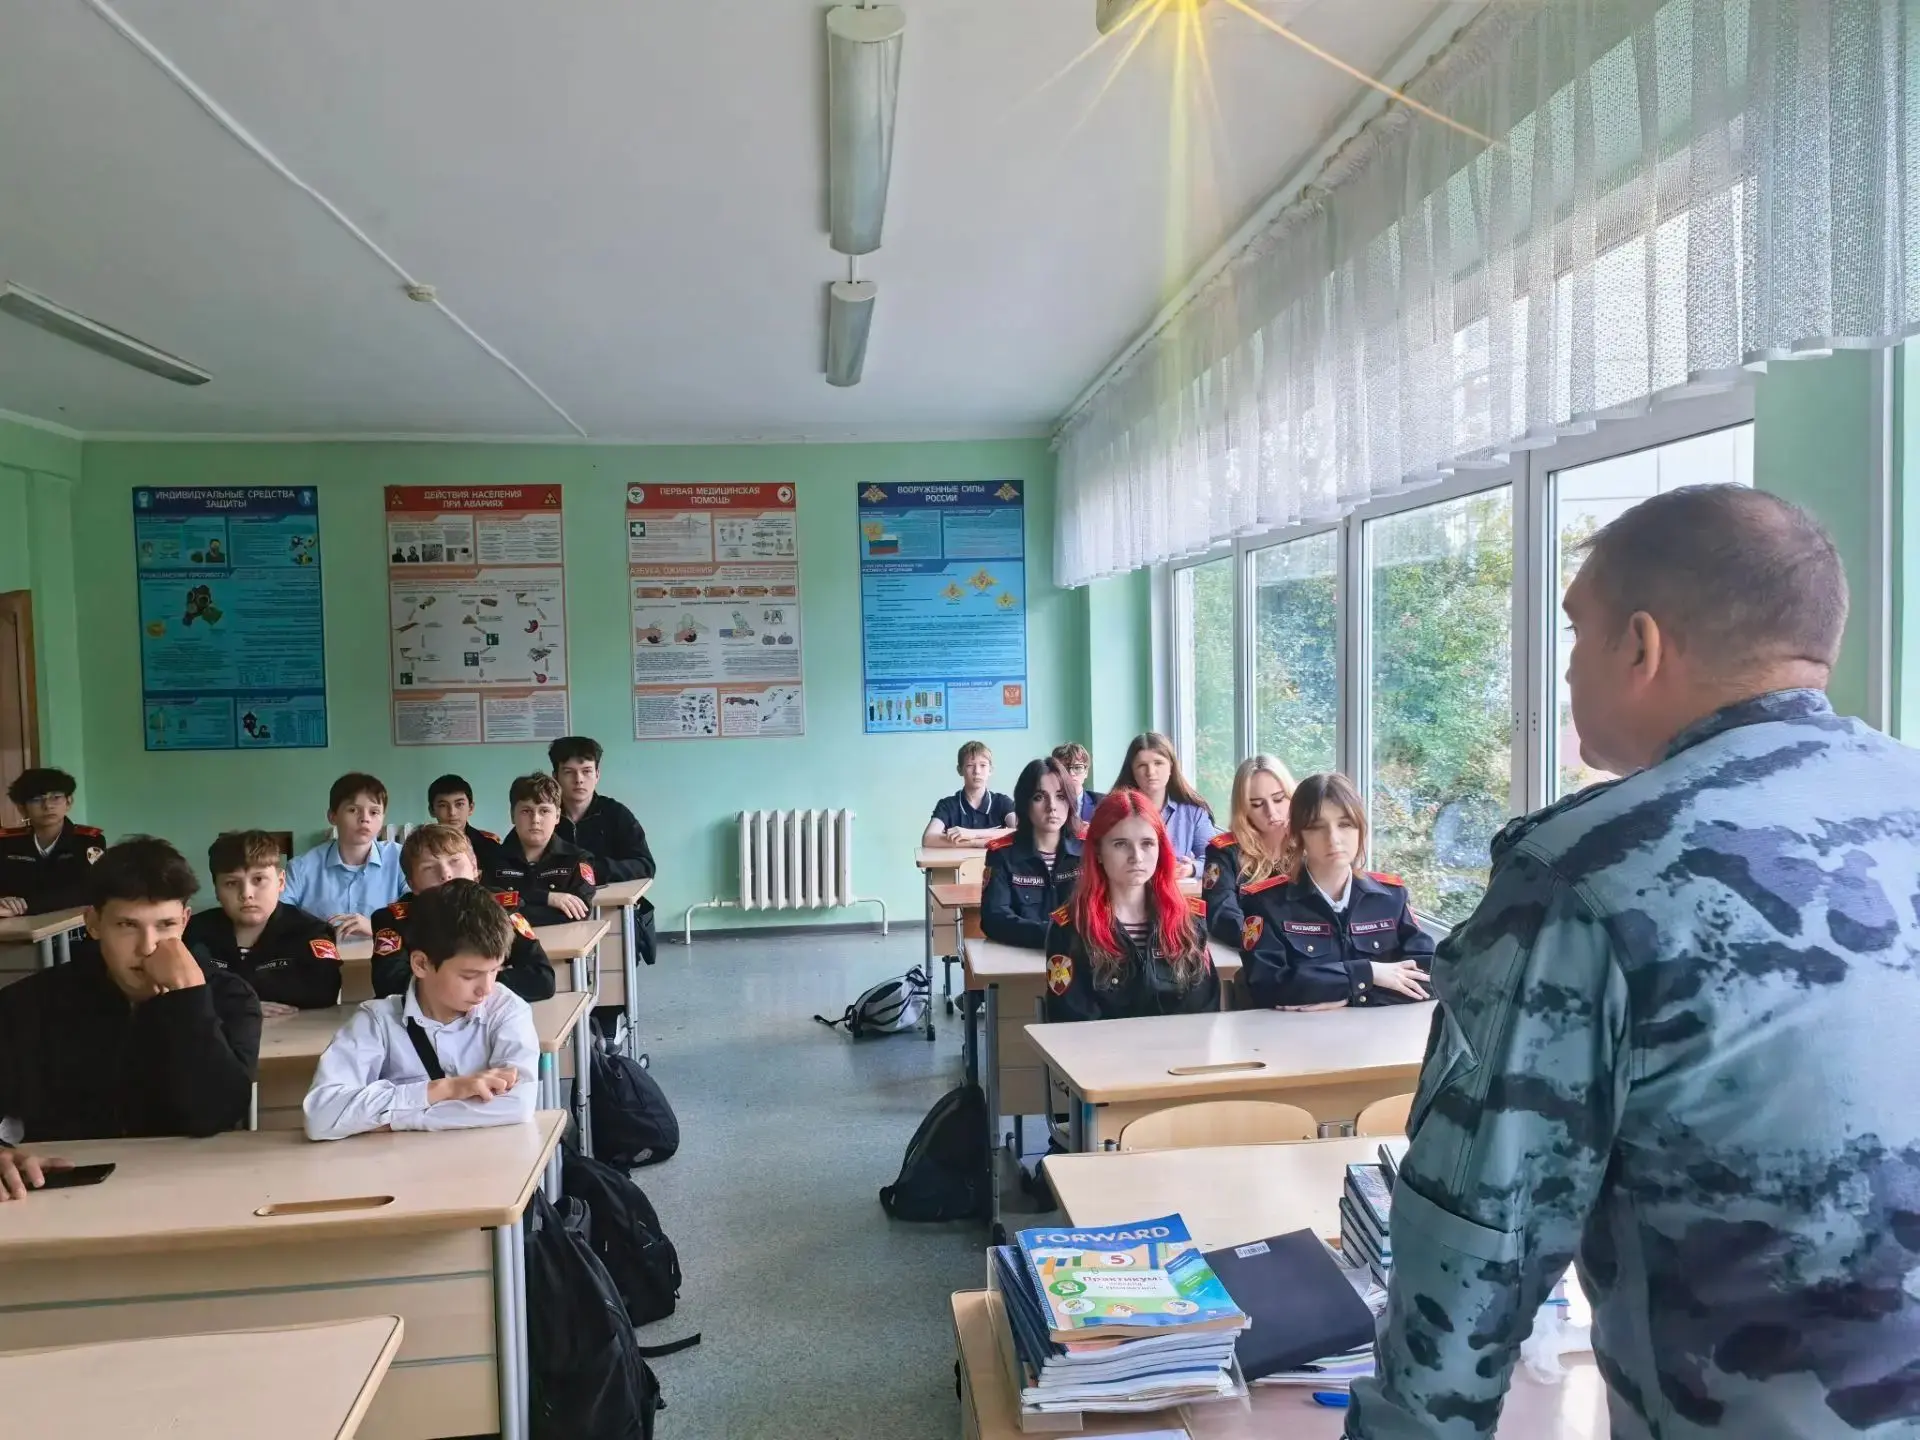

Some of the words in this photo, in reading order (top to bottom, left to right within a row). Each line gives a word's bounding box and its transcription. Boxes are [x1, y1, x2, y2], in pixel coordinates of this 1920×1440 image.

[659, 487, 693, 495] ПЕРВАЯ
[695, 487, 760, 496] МЕДИЦИНСКАЯ
[897, 485, 959, 494] ВООРУЖЕННЫЕ
[961, 485, 985, 493] СИЛЫ
[155, 490, 245, 499] ИНДИВИДУАЛЬНЫЕ
[247, 490, 296, 499] СРЕДСТВА
[424, 490, 469, 499] ДЕЙСТВИЯ
[472, 490, 522, 498] НАСЕЛЕНИЯ
[925, 494, 958, 502] РОССИИ
[205, 499, 247, 508] ЗАЩИТЫ
[443, 500, 461, 508] ПРИ
[464, 500, 504, 508] АВАРИЯХ
[690, 496, 730, 505] ПОМОЩЬ
[1034, 1226, 1170, 1244] FORWARD
[1110, 1254, 1125, 1265] 5
